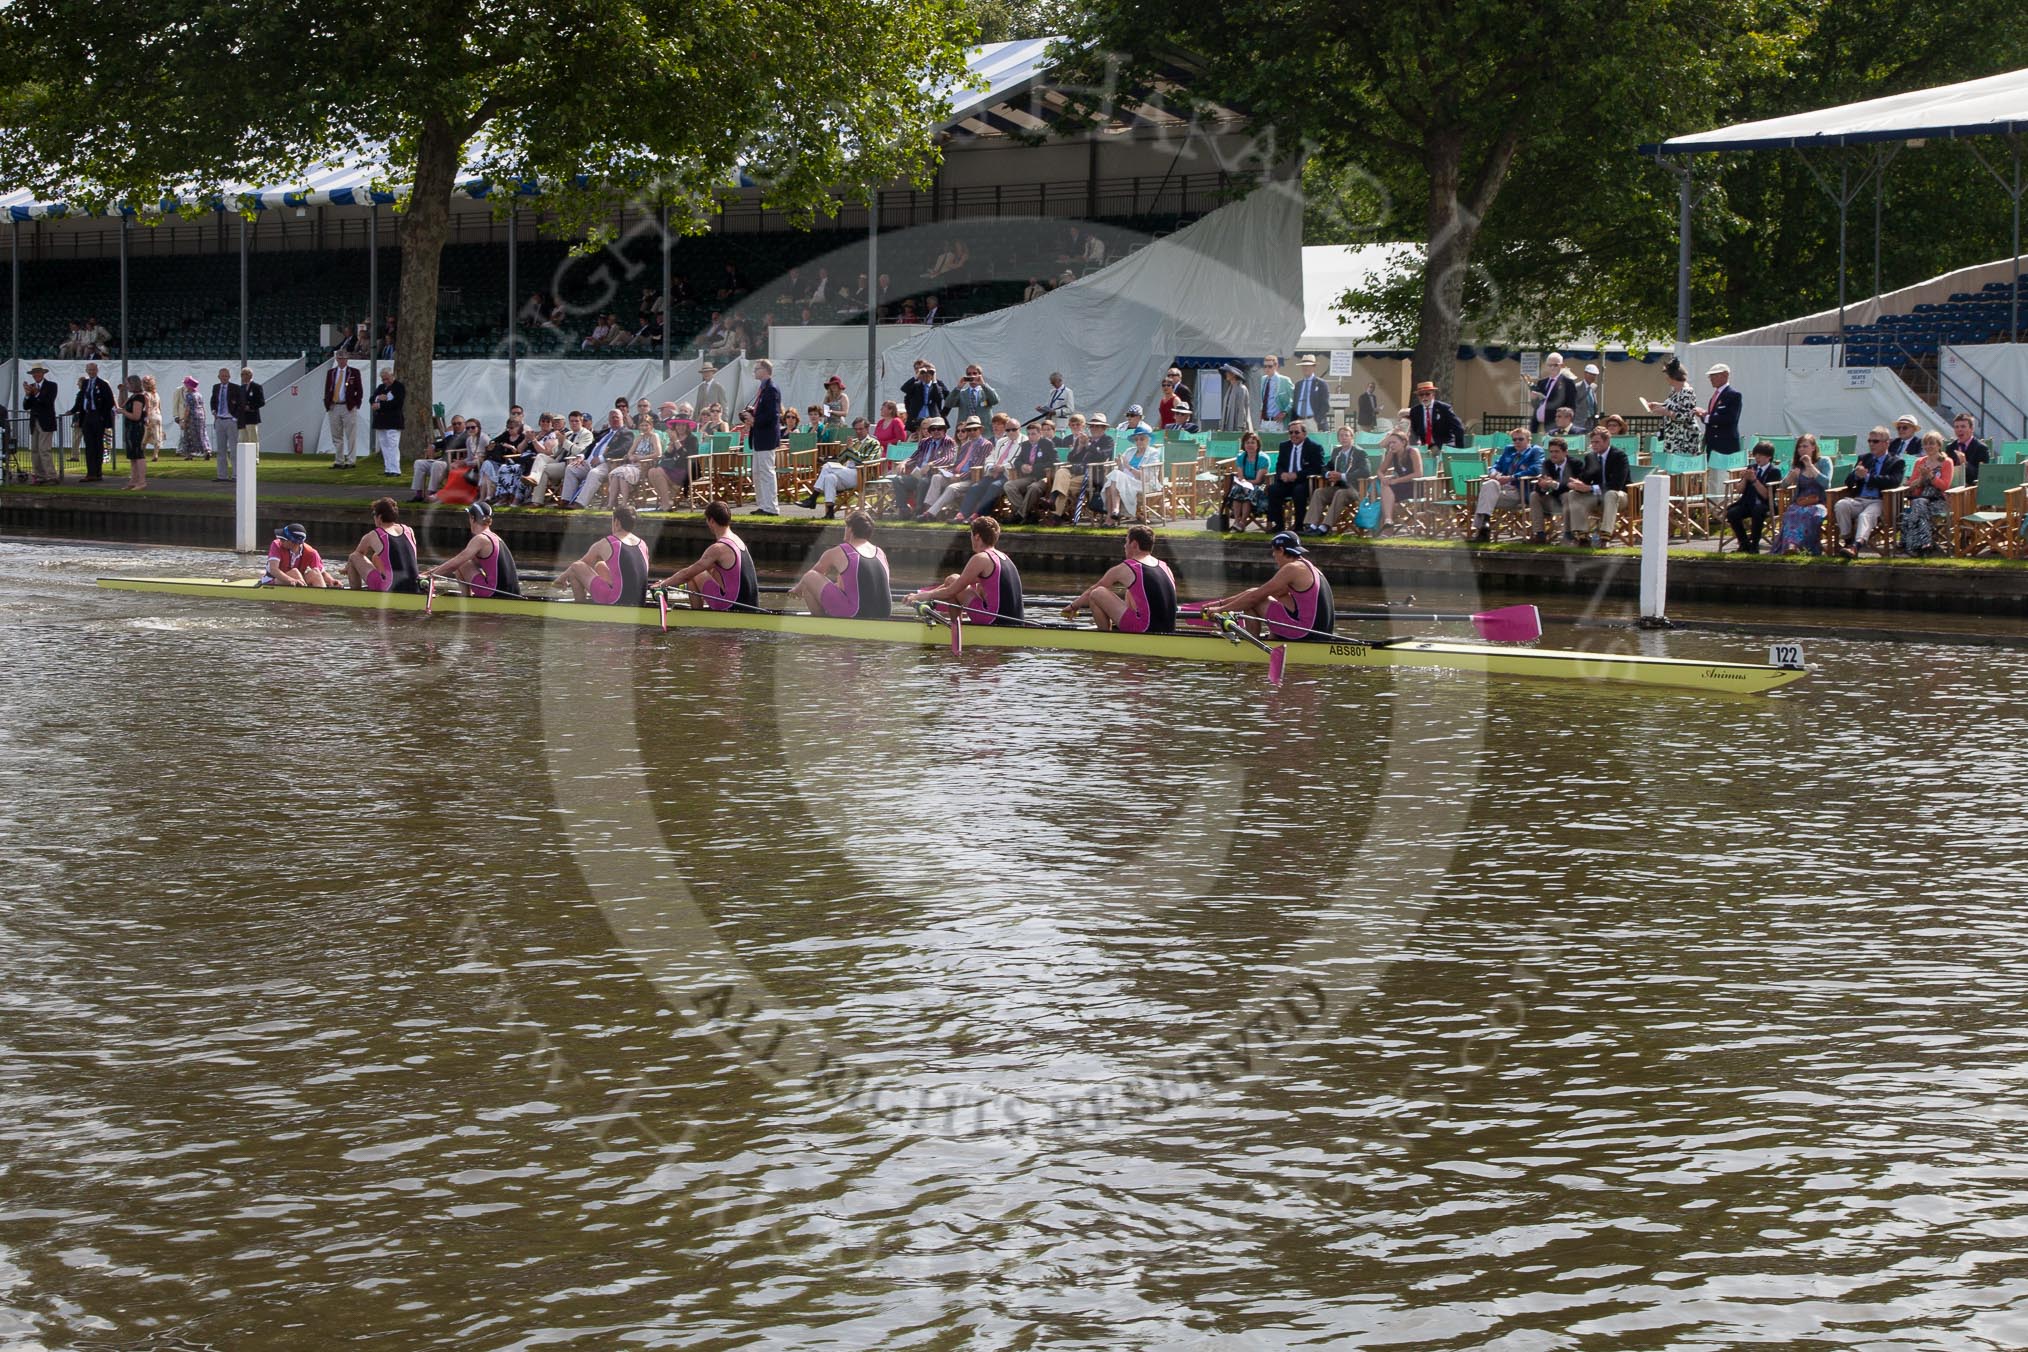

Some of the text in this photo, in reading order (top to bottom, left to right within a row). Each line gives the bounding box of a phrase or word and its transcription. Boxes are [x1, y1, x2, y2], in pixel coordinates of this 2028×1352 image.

[1329, 645, 1367, 656] ABS801
[1775, 646, 1798, 663] 122
[1701, 667, 1747, 680] Animus
